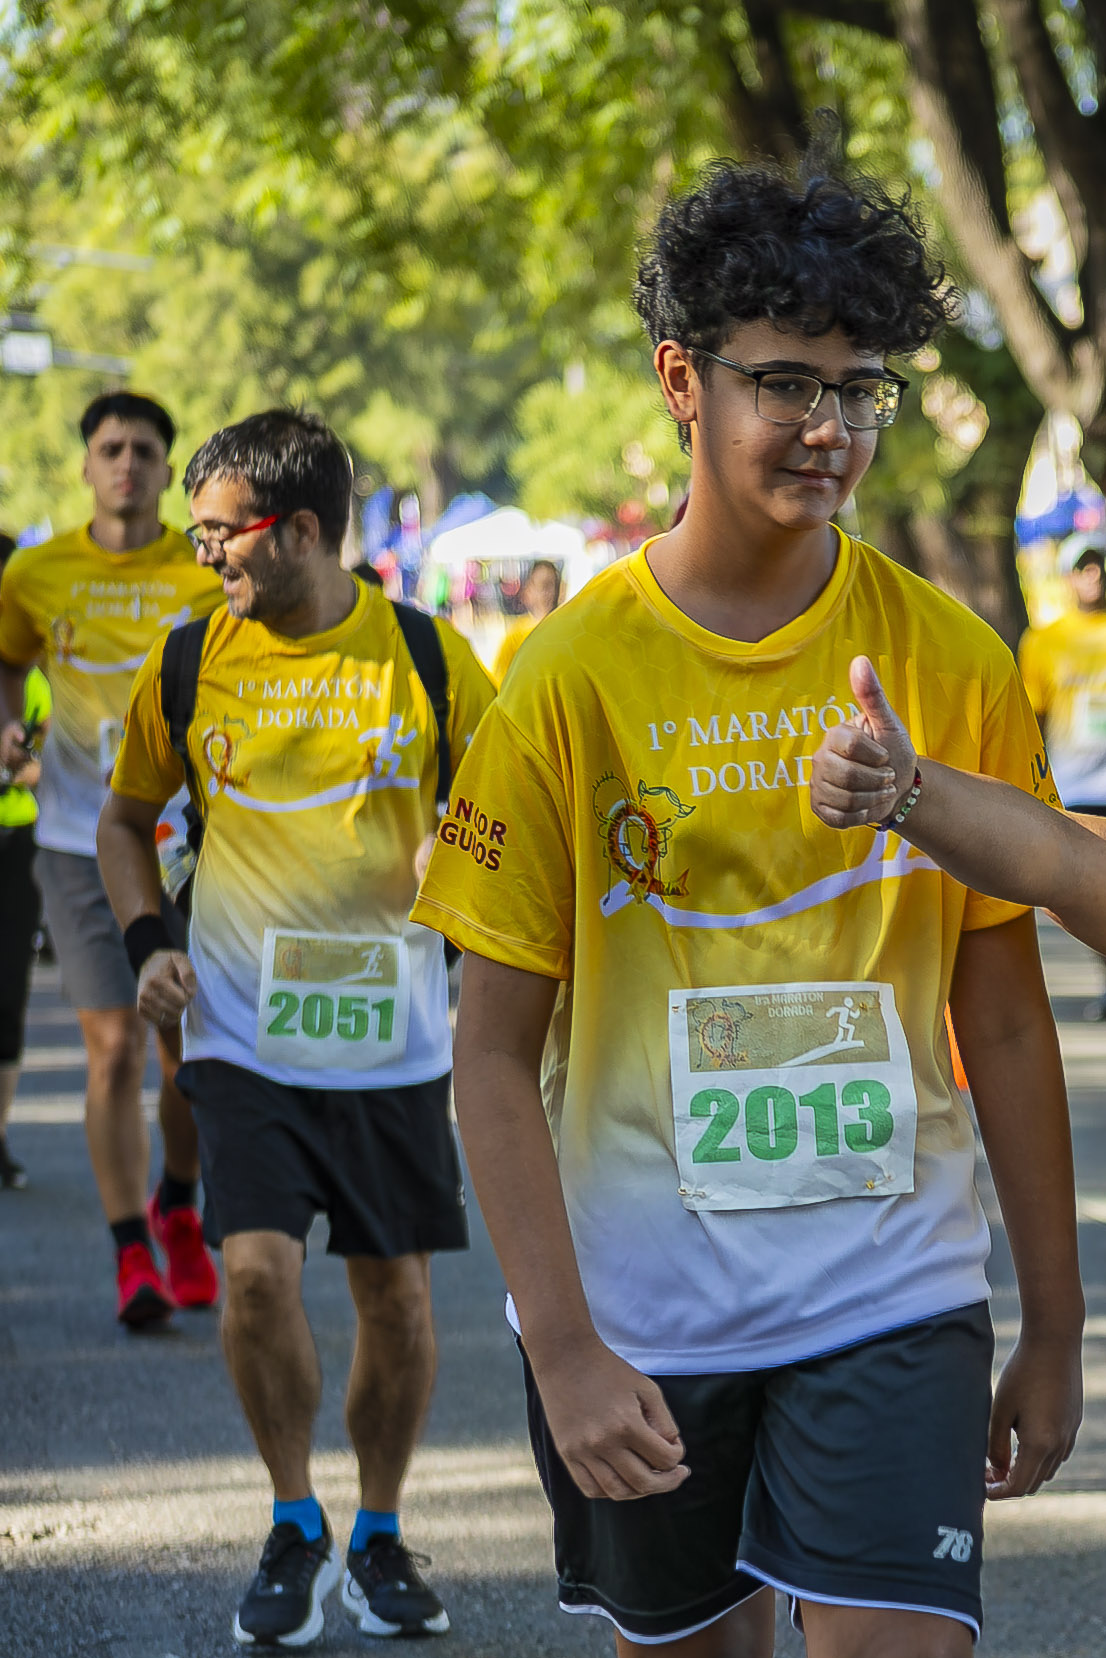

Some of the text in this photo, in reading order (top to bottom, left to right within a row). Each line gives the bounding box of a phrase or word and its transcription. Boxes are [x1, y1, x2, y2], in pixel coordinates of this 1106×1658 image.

[262, 672, 381, 699] MARATÓN
[257, 706, 359, 729] DORADA
[688, 755, 813, 797] DORAD
[267, 991, 395, 1042] 2051
[690, 1079, 894, 1163] 2013
[933, 1525, 974, 1563] 78
